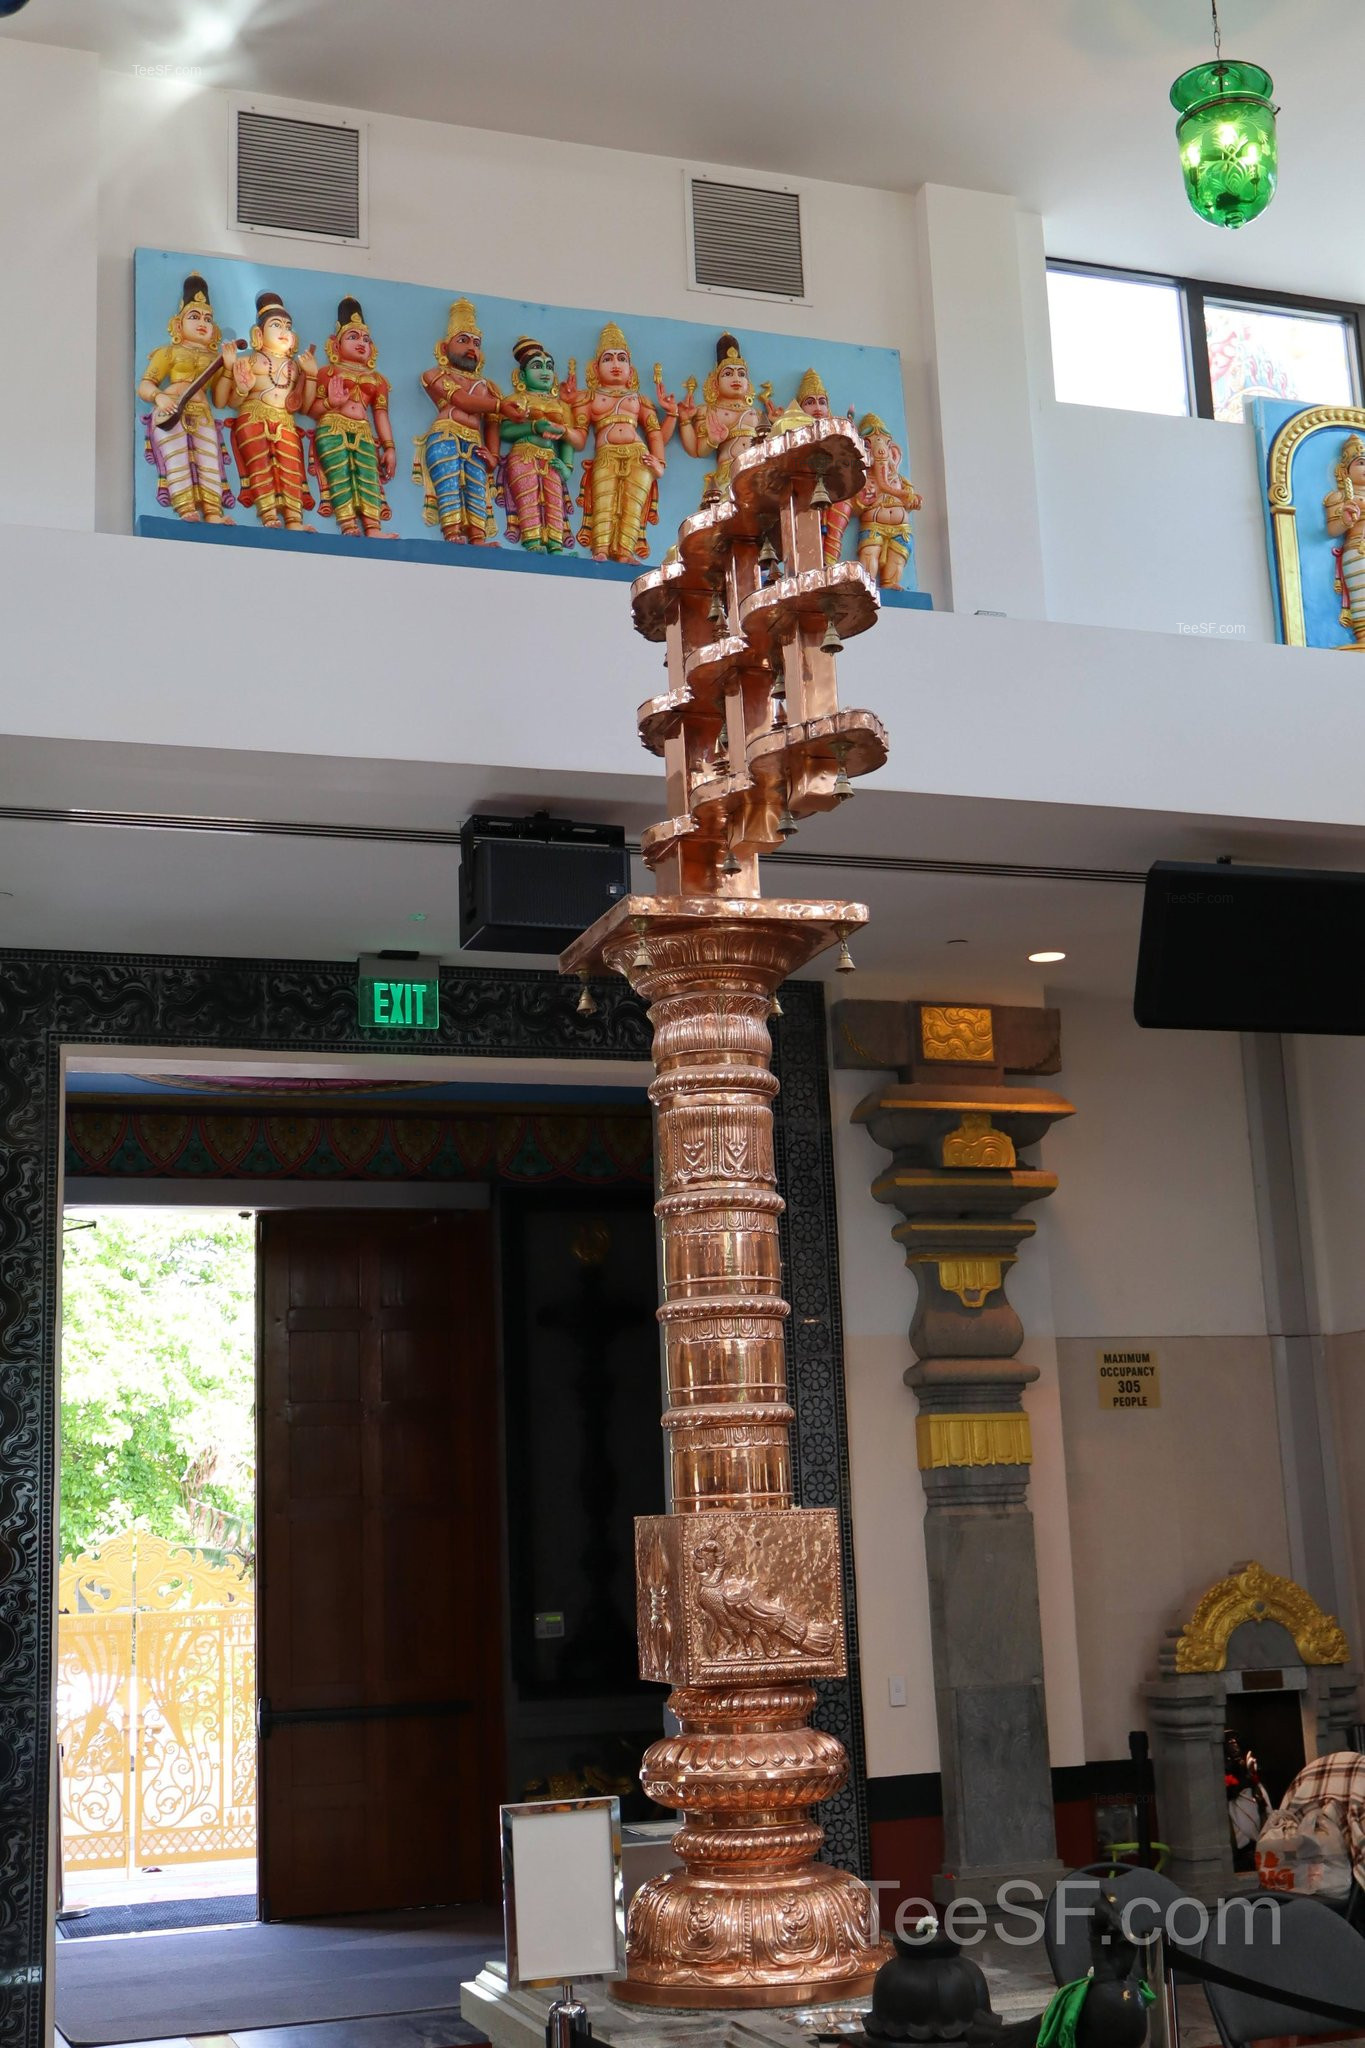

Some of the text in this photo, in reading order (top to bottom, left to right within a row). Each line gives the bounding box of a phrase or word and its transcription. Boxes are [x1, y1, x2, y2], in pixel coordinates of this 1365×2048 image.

[374, 983, 427, 1025] EXIT
[1103, 1353, 1150, 1364] MAXIMUM
[1100, 1366, 1155, 1377] OCCUPANCY
[1118, 1380, 1141, 1393] 305
[1113, 1396, 1148, 1407] PEOPLE
